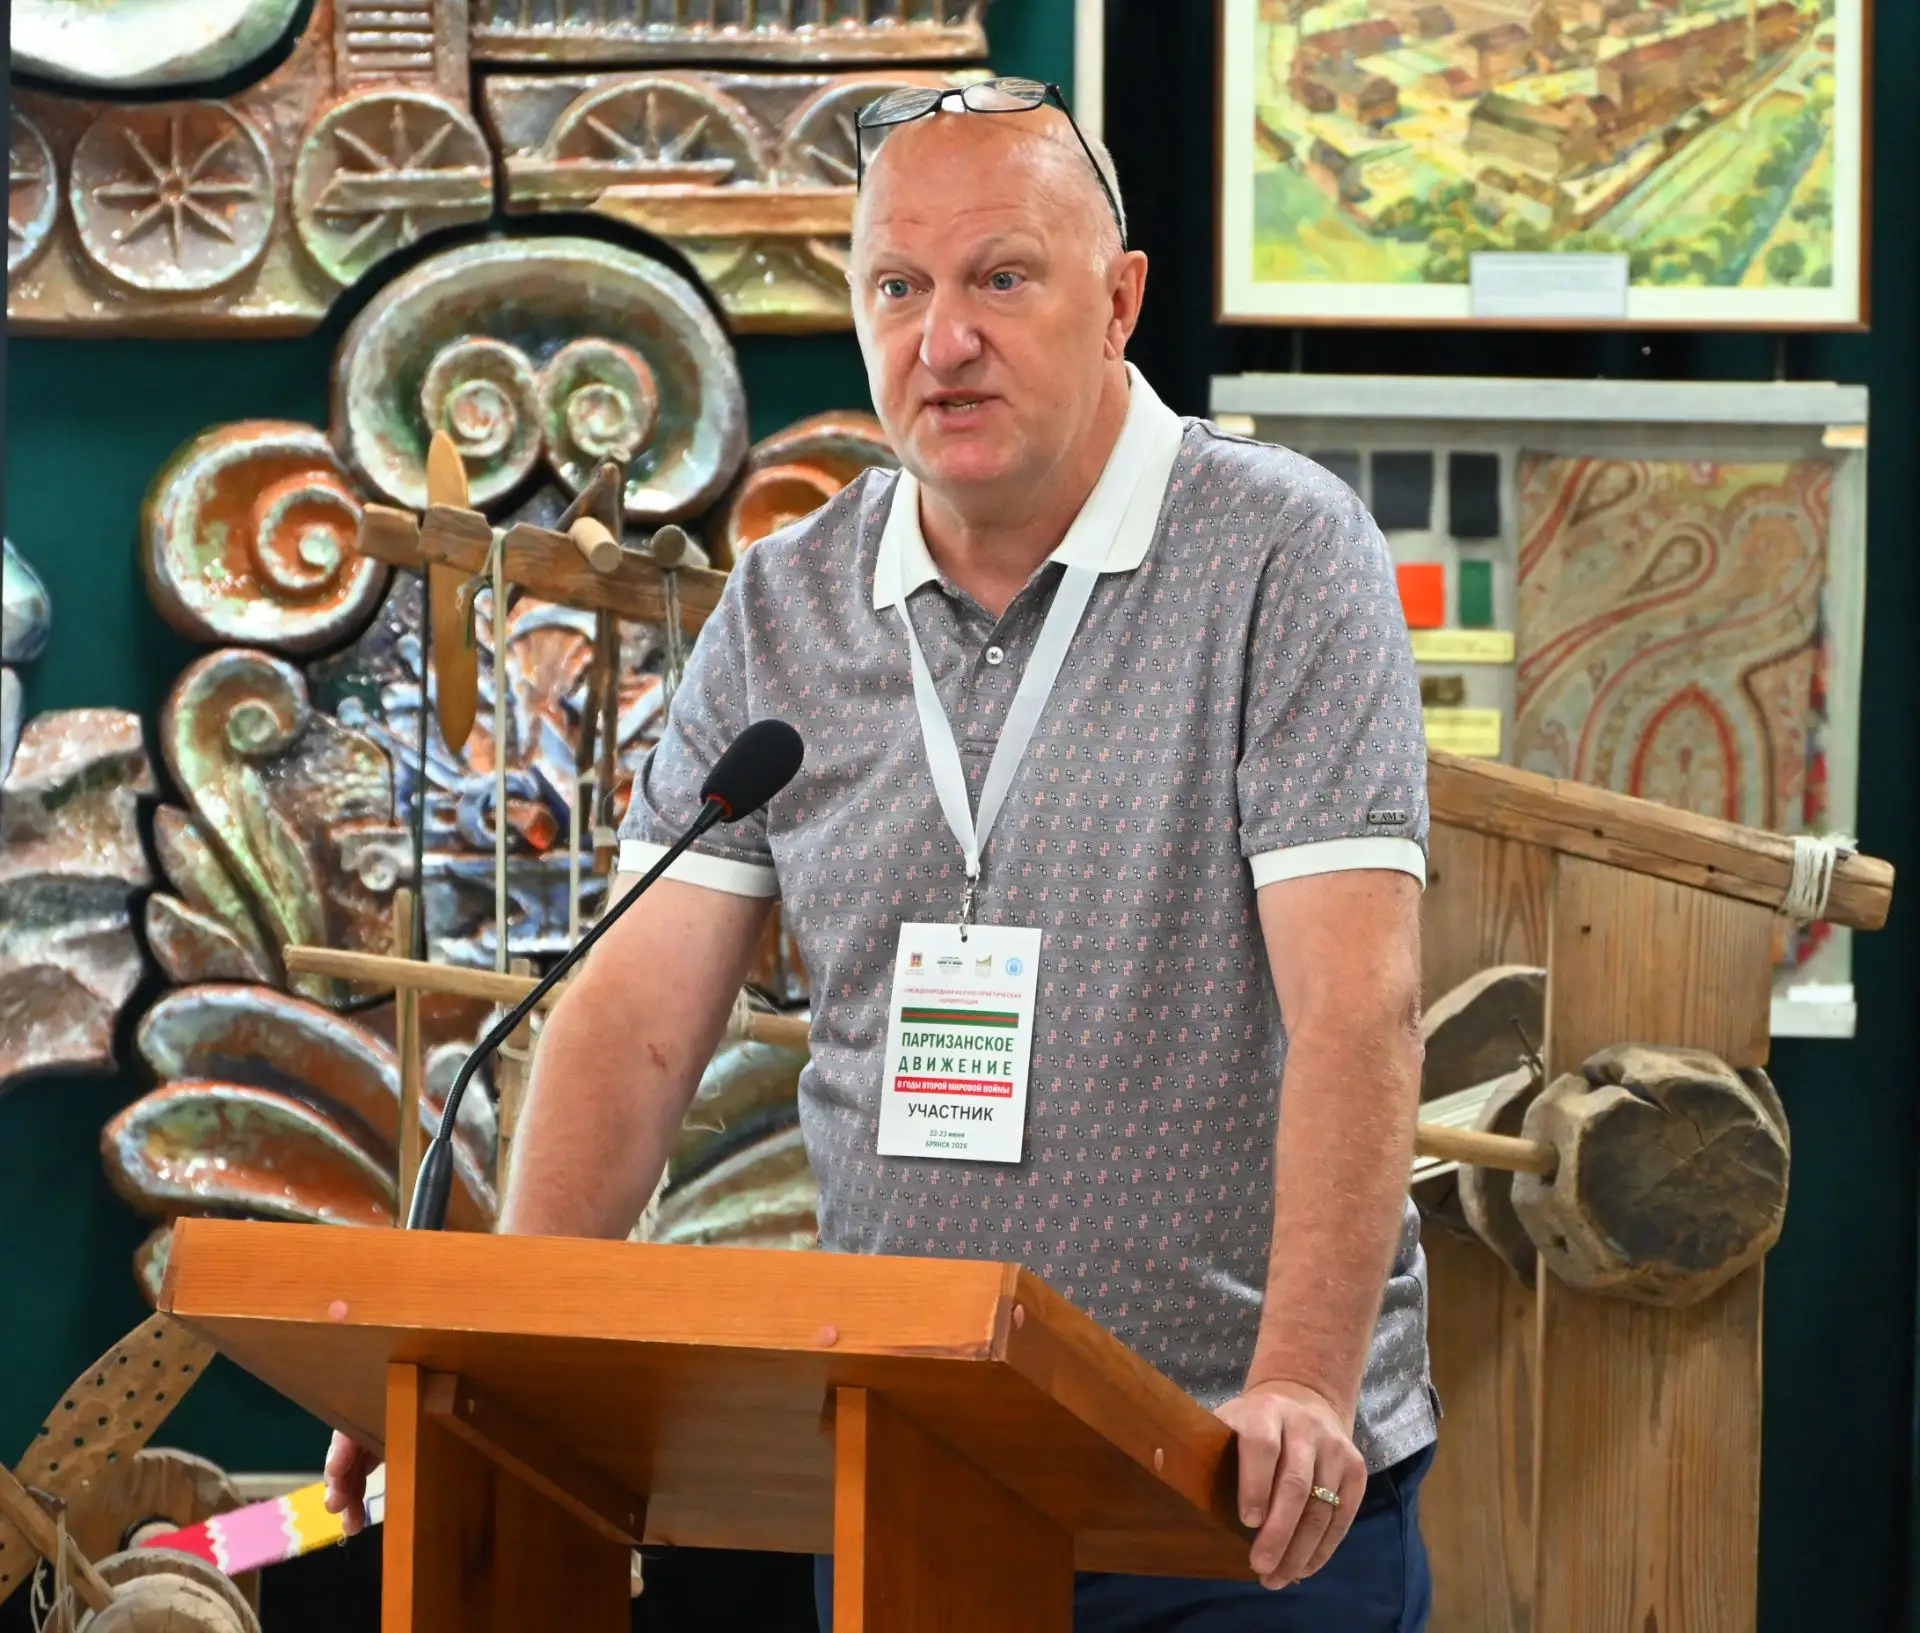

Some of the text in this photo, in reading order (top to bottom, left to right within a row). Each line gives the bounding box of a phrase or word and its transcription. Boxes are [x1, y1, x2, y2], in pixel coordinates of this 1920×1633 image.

[901, 1032, 1014, 1052] ПАРТИЗАНСКОЕ
[898, 1055, 1013, 1076] ДВИЖЕНИЕ
[897, 1080, 1010, 1094] В ГОДЫ ВТОРОЙ МИРОВОЙ ВОЙНЫ
[908, 1102, 994, 1121] УЧАСТНИК
[925, 1140, 950, 1149] БРЯНСК
